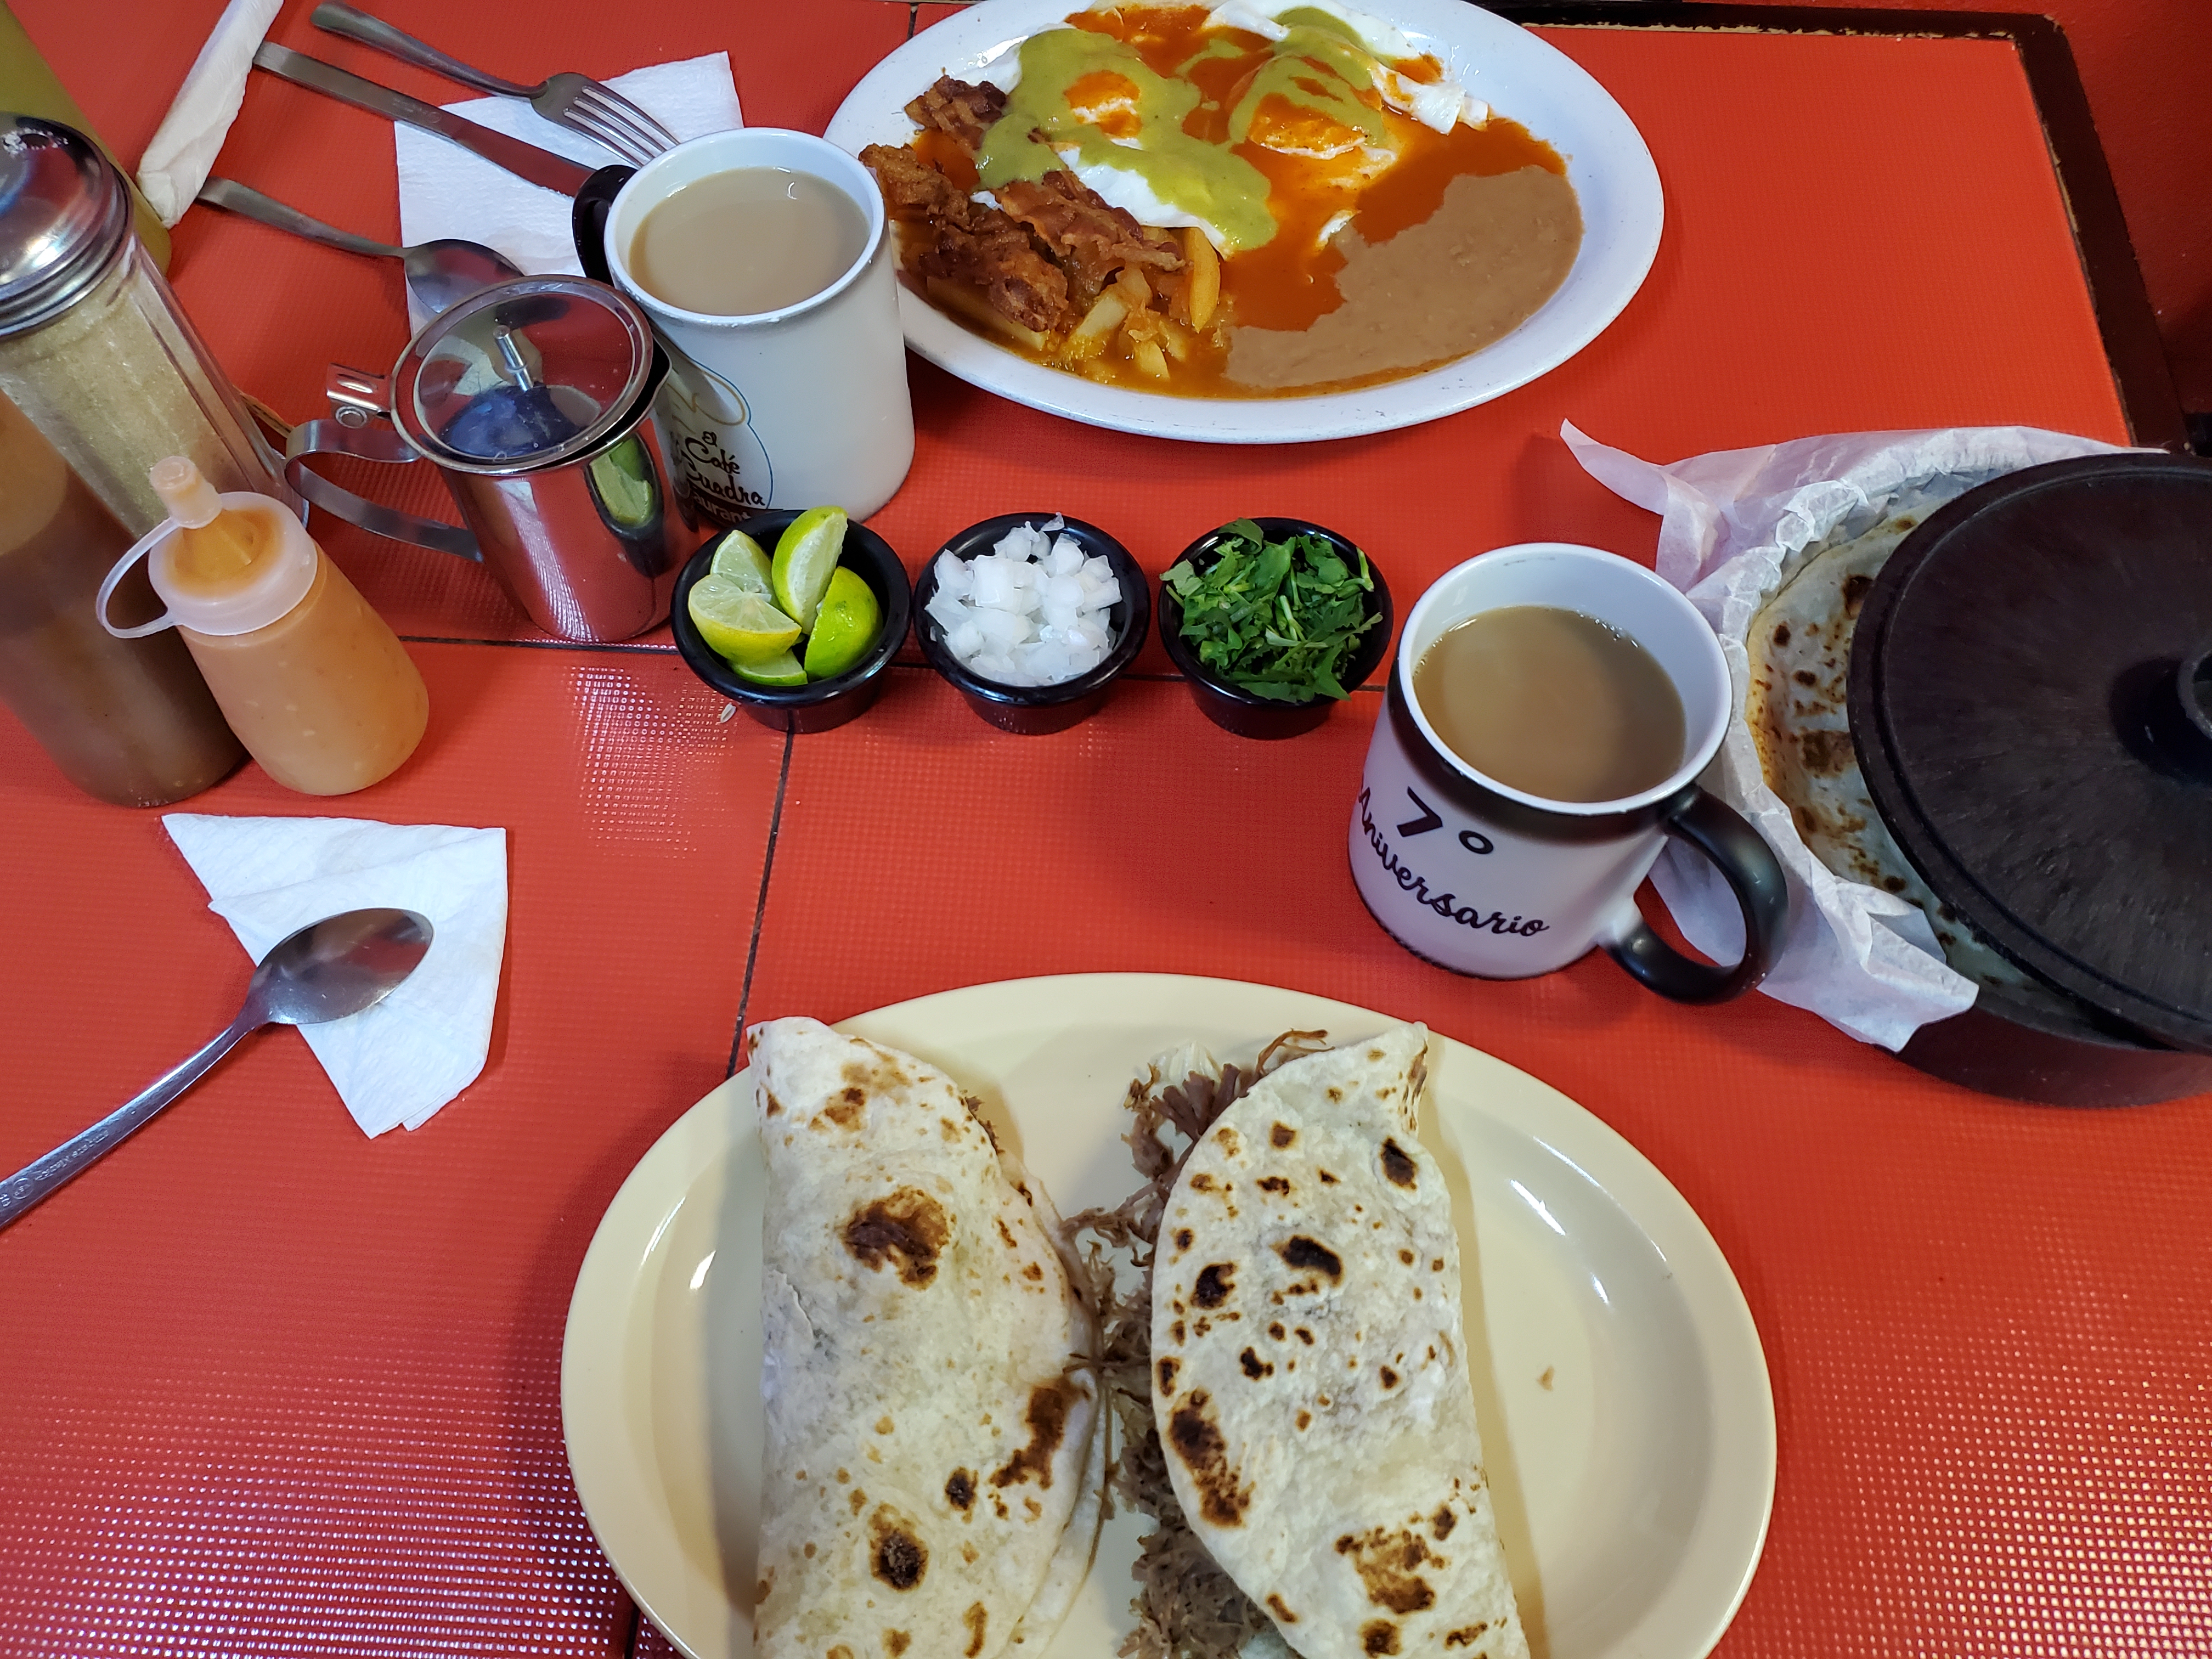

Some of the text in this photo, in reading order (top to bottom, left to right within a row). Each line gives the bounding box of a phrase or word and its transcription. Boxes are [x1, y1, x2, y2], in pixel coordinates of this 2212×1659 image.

[685, 437, 741, 475] Café
[693, 492, 752, 523] aurant
[1358, 786, 1550, 937] Aniversario
